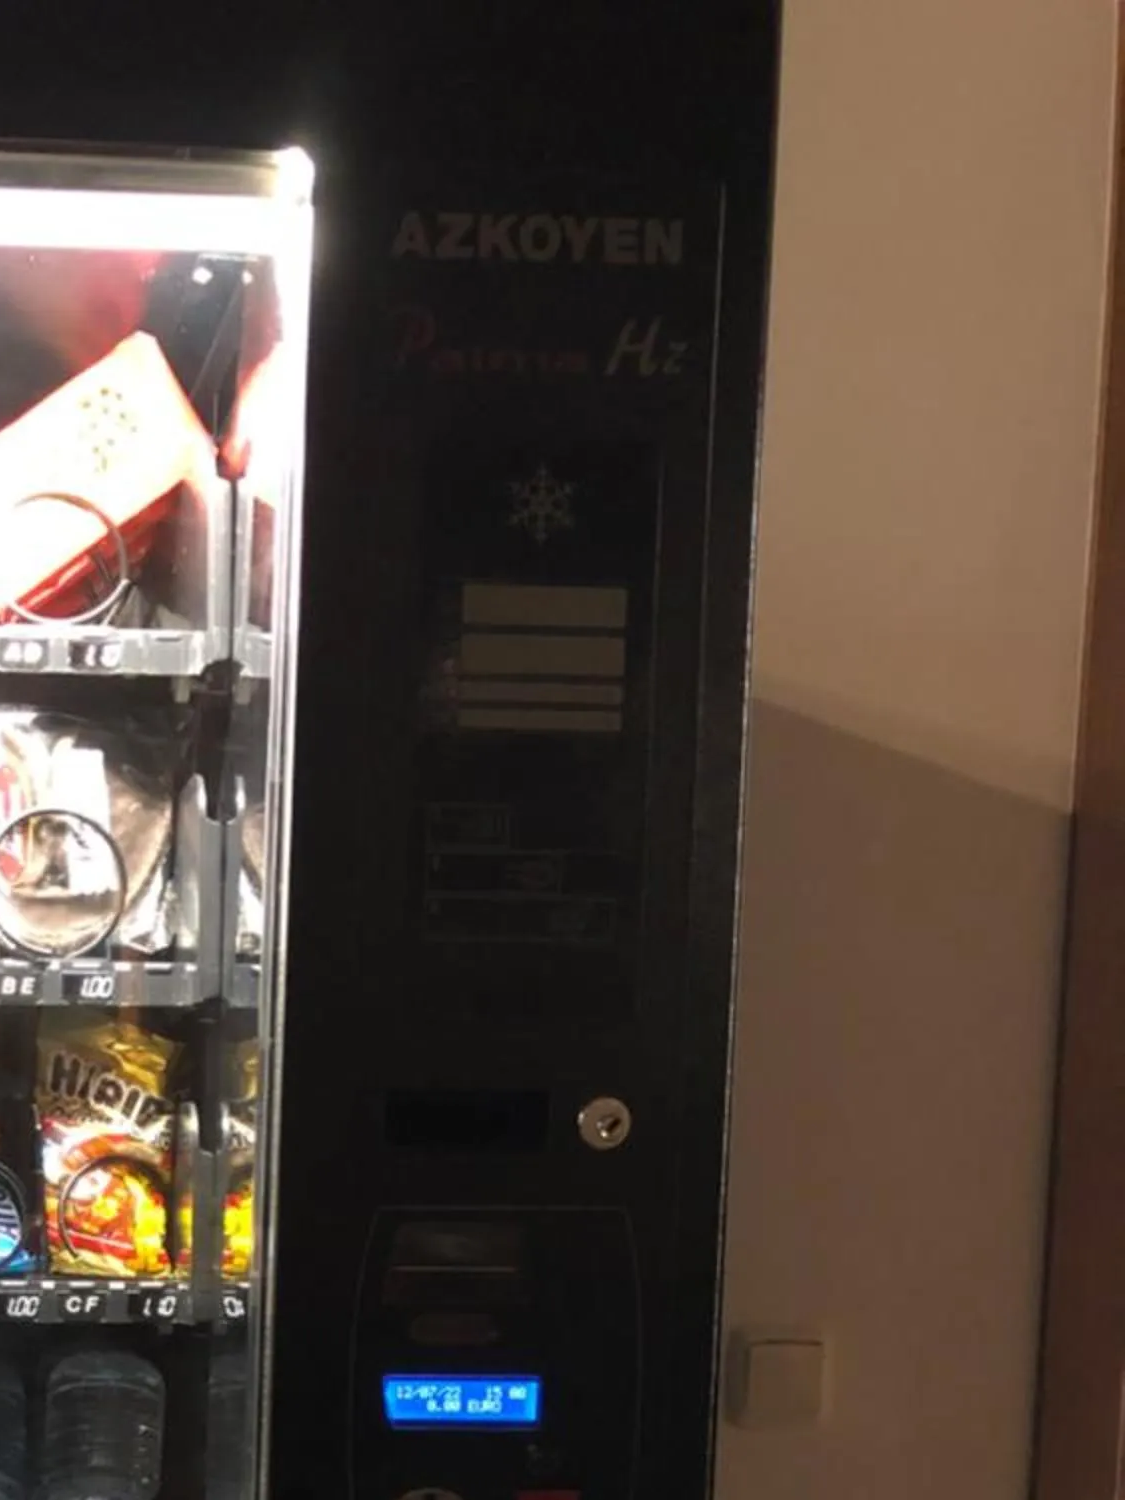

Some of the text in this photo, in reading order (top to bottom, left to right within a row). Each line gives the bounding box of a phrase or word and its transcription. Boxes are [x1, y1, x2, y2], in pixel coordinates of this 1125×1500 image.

[391, 210, 685, 265] AZKOYEN
[1, 975, 36, 995] BE
[65, 1295, 100, 1313] CF
